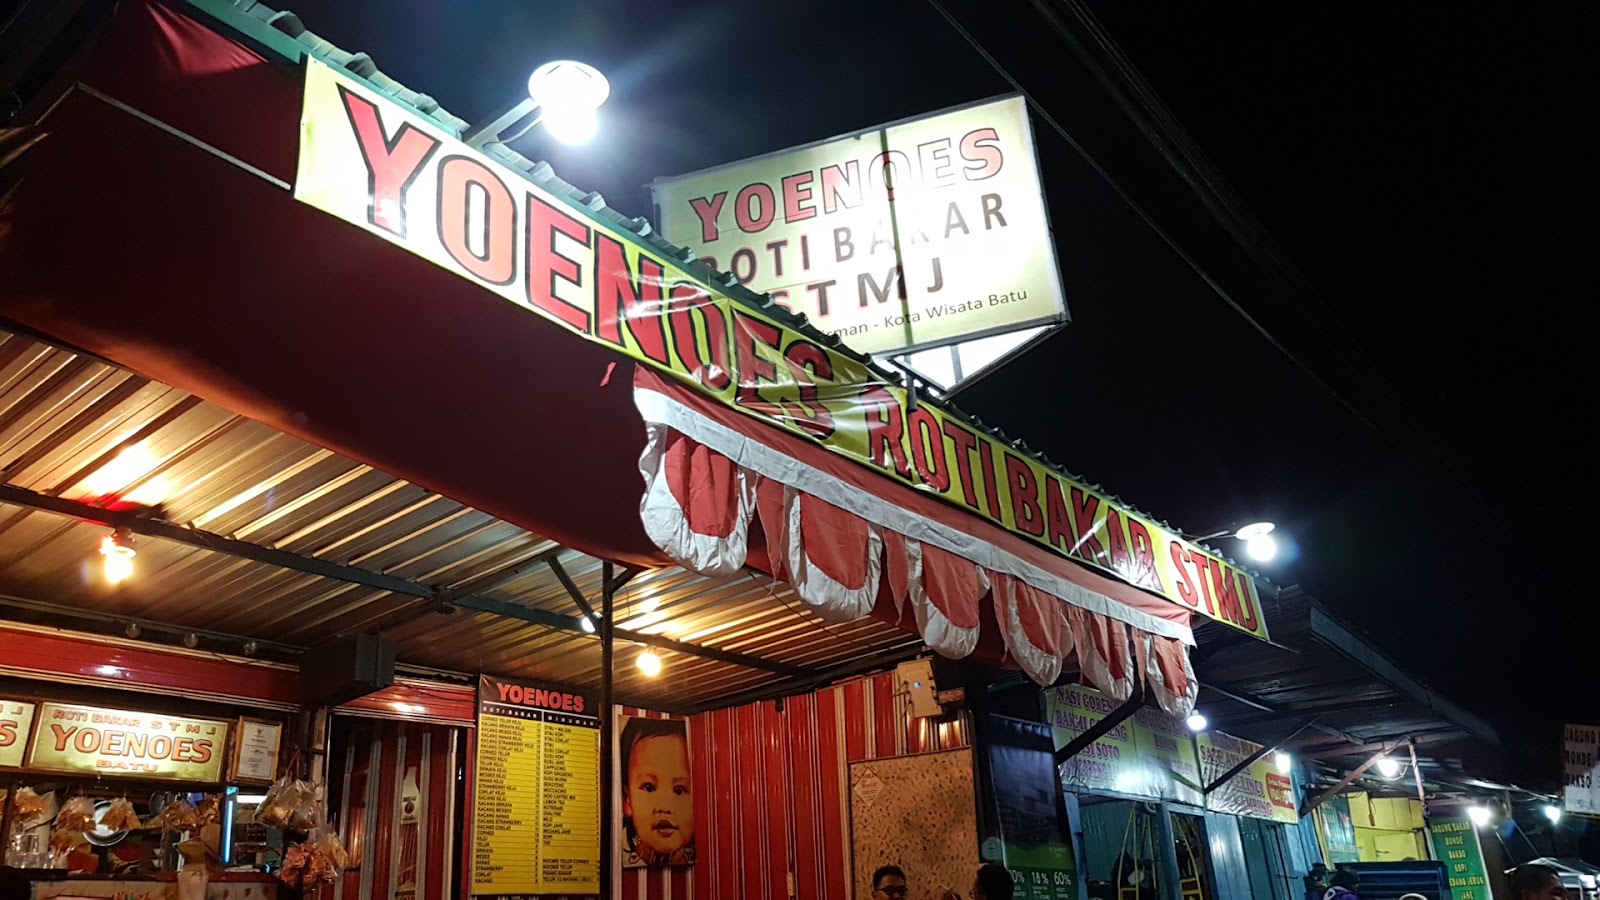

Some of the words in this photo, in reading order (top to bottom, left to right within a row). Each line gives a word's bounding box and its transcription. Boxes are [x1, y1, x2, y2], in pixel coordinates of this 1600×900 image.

[689, 127, 1004, 243] YOENOES
[335, 82, 836, 439] YOENOES
[884, 311, 921, 329] Kota
[926, 299, 983, 320] Wisata
[988, 289, 1028, 307] Batu
[859, 385, 1003, 523] ROTI
[1004, 452, 1164, 593] BAKAR
[1169, 540, 1259, 632] STMJ
[497, 682, 585, 713] YOENOES
[1057, 688, 1081, 707] NASI
[53, 709, 87, 722] ROTI
[92, 713, 140, 727] BAKAR
[51, 724, 213, 763] YOENOES
[1565, 728, 1596, 744] JAGUNG
[1096, 742, 1120, 761] SOTO
[96, 759, 158, 772] BATU
[1054, 871, 1072, 885] 60%
[1449, 877, 1466, 887] EDANG
